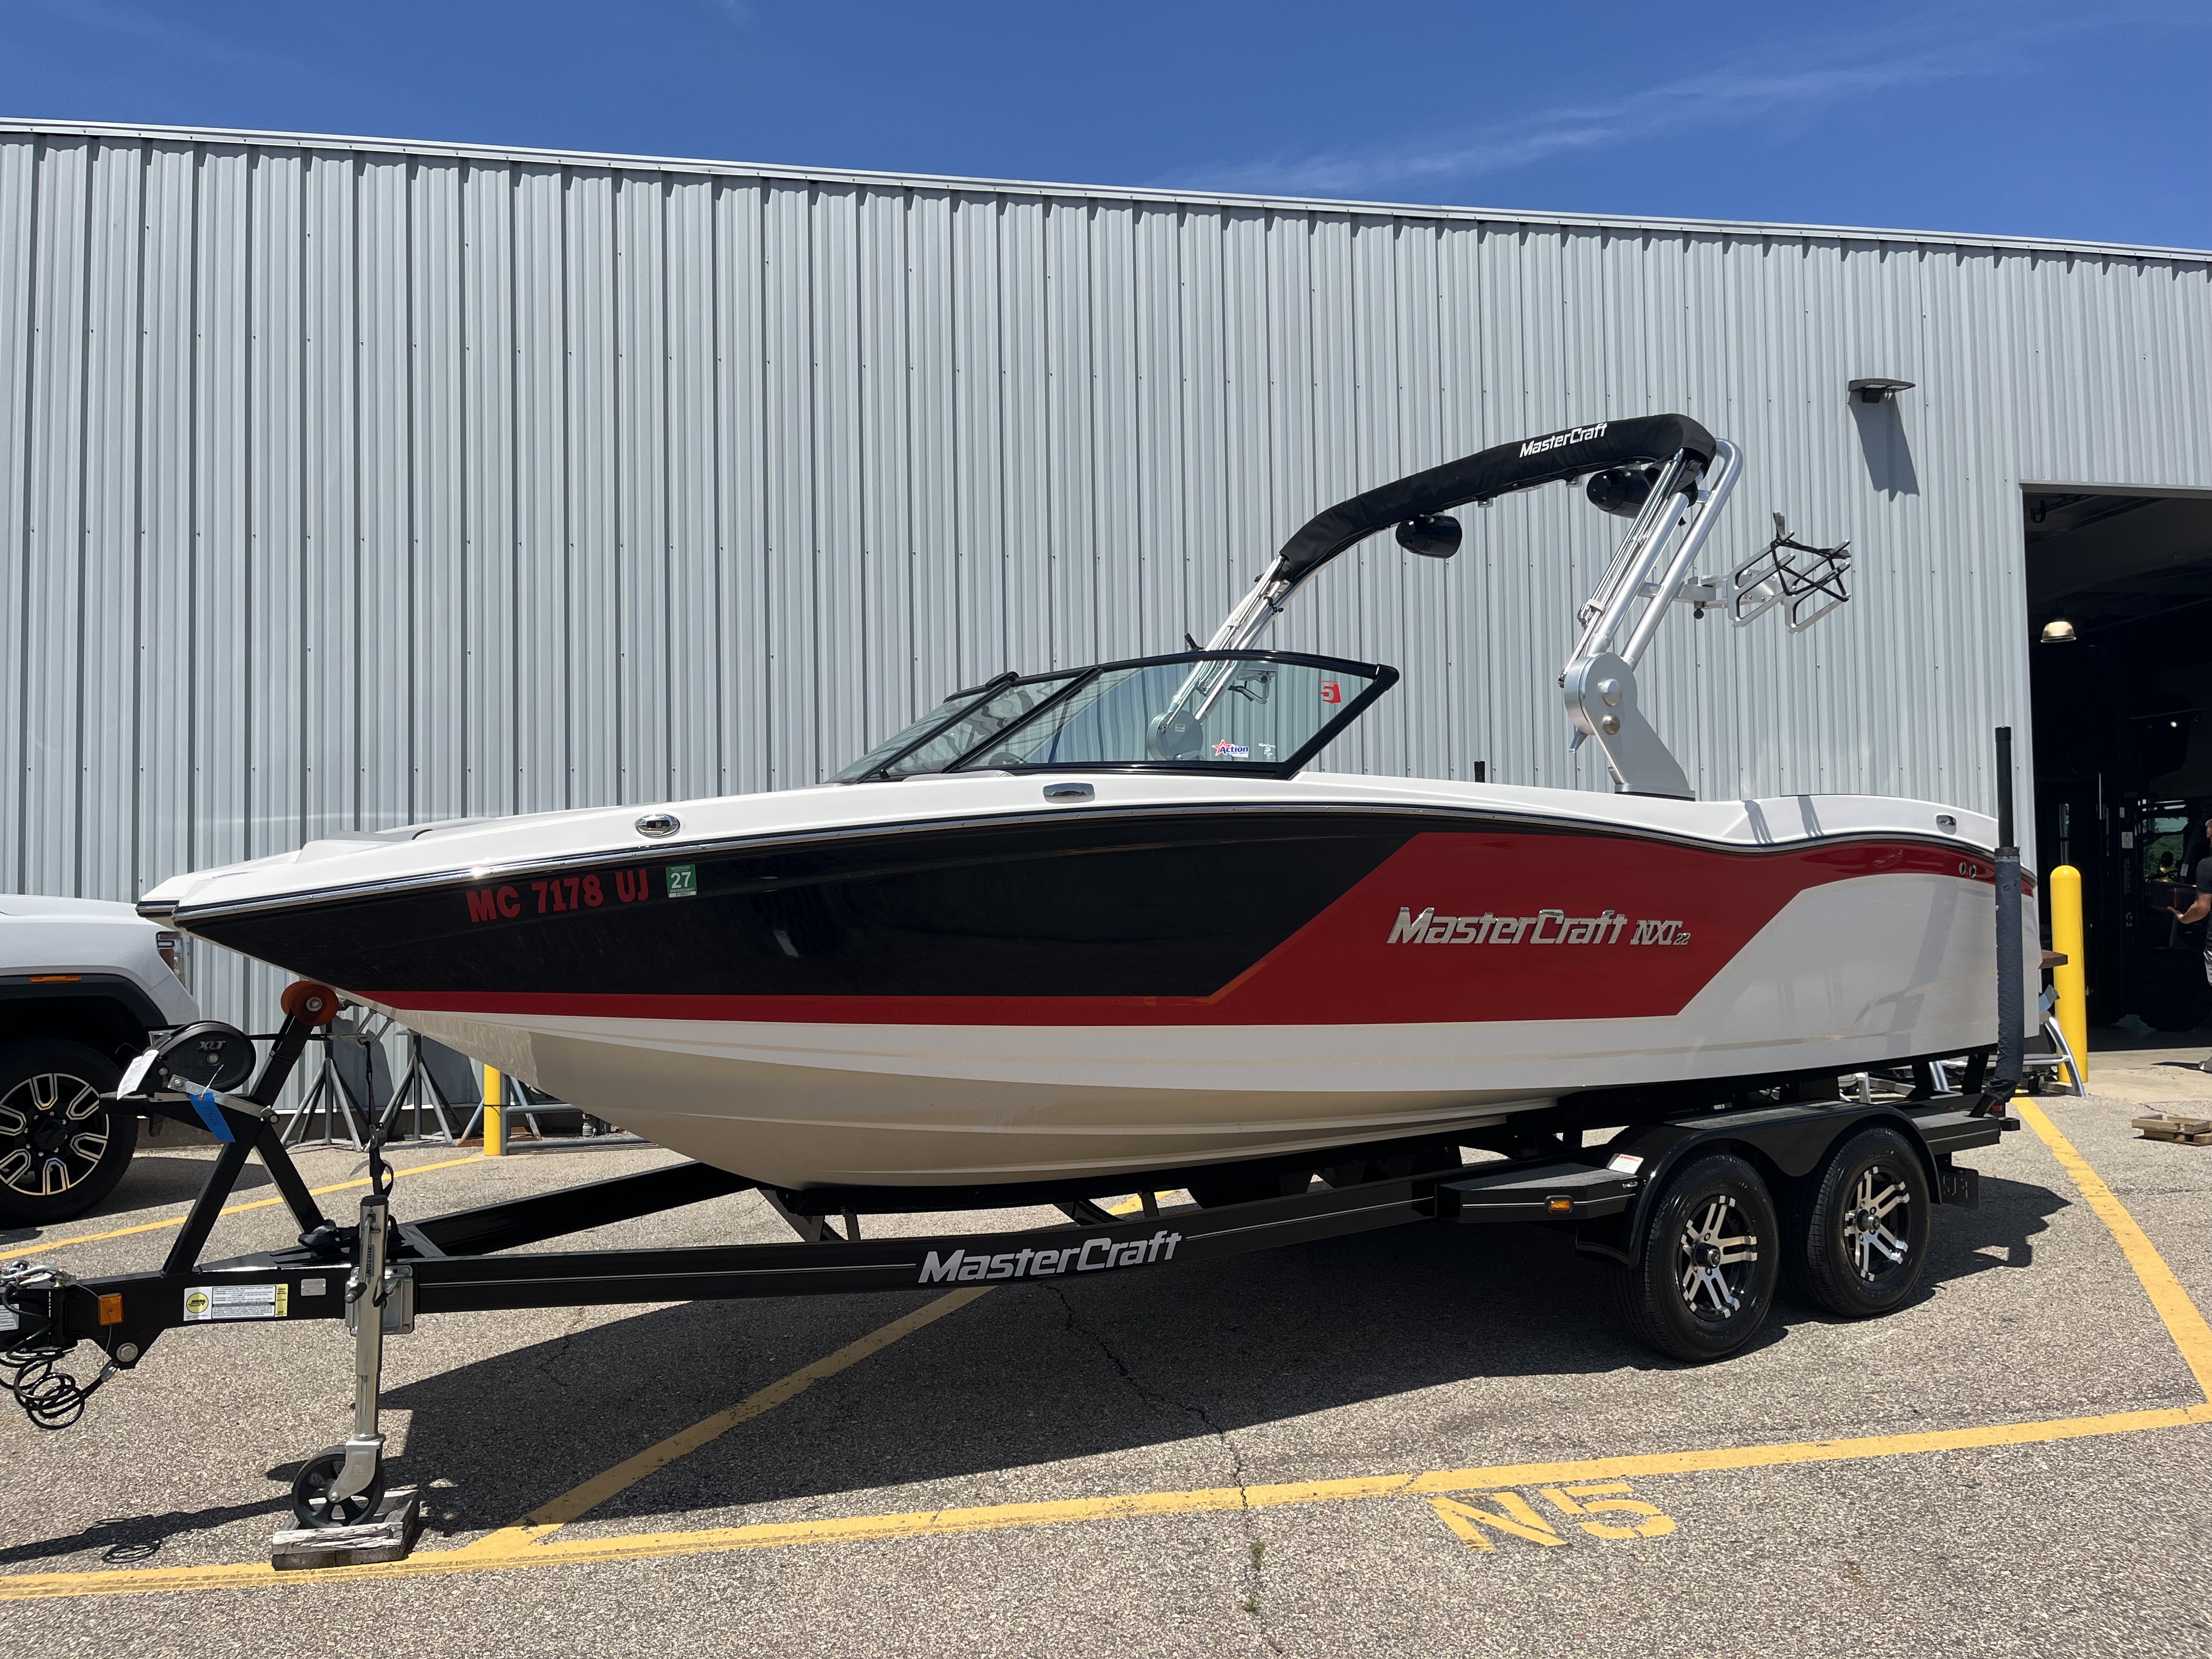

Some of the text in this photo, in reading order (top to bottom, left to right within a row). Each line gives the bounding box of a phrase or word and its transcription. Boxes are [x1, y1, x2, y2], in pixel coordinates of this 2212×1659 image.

[1519, 422, 1608, 458] MasterCraft
[1220, 746, 1249, 754] Action
[466, 868, 650, 923] MC 7178 UJ
[670, 871, 692, 889] 27
[1387, 906, 1691, 946] MasterCraft NXT 22
[197, 1040, 227, 1051] XLT
[918, 1229, 1182, 1283] MasterCraft
[1425, 1482, 1677, 1551] N5
